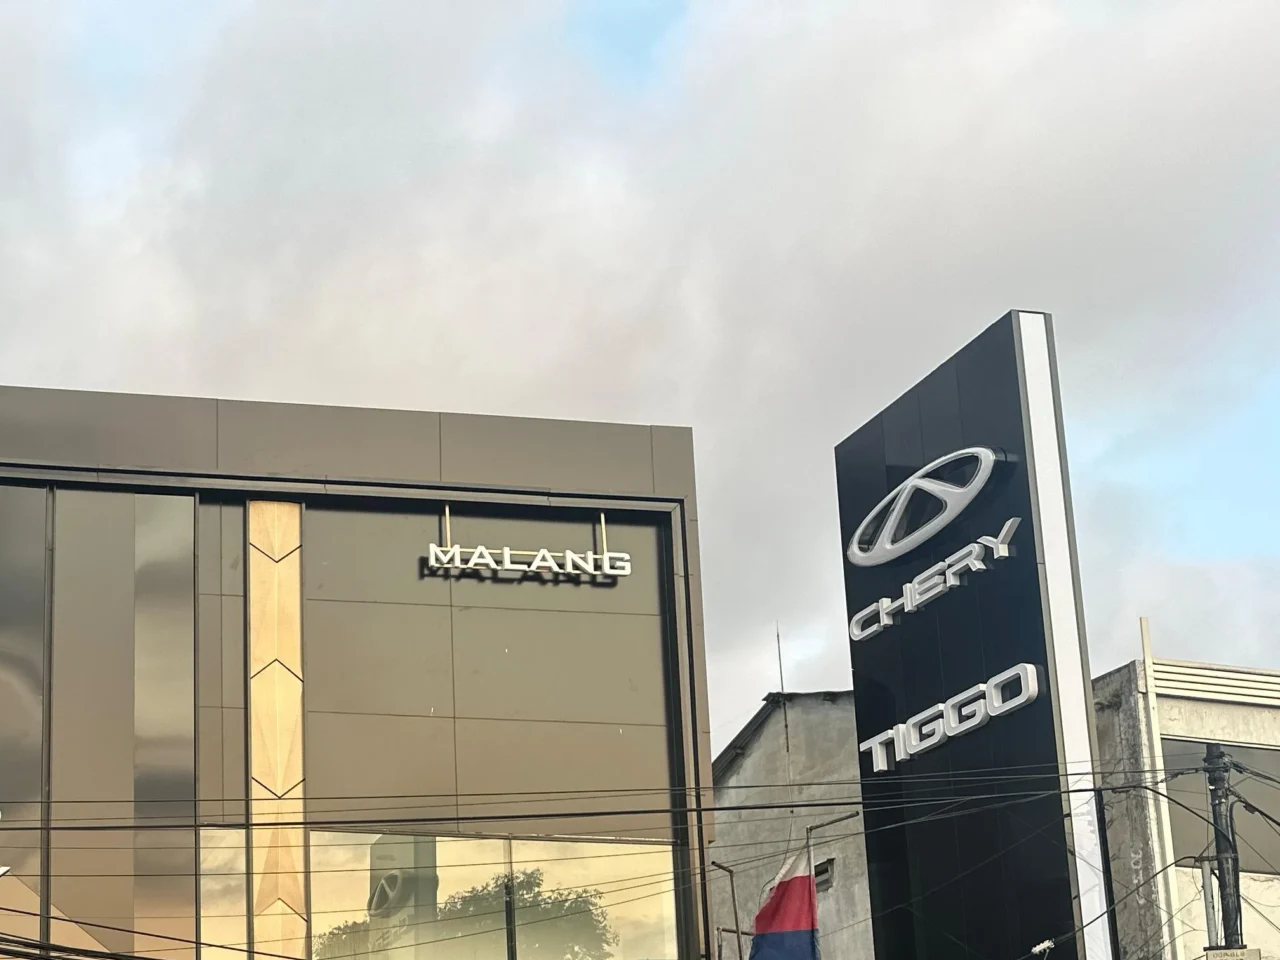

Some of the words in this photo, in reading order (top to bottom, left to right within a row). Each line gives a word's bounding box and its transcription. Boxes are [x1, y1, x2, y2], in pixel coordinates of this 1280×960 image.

[429, 543, 632, 576] MALANG
[849, 517, 1022, 641] CHERY
[860, 662, 1038, 773] TIGGO
